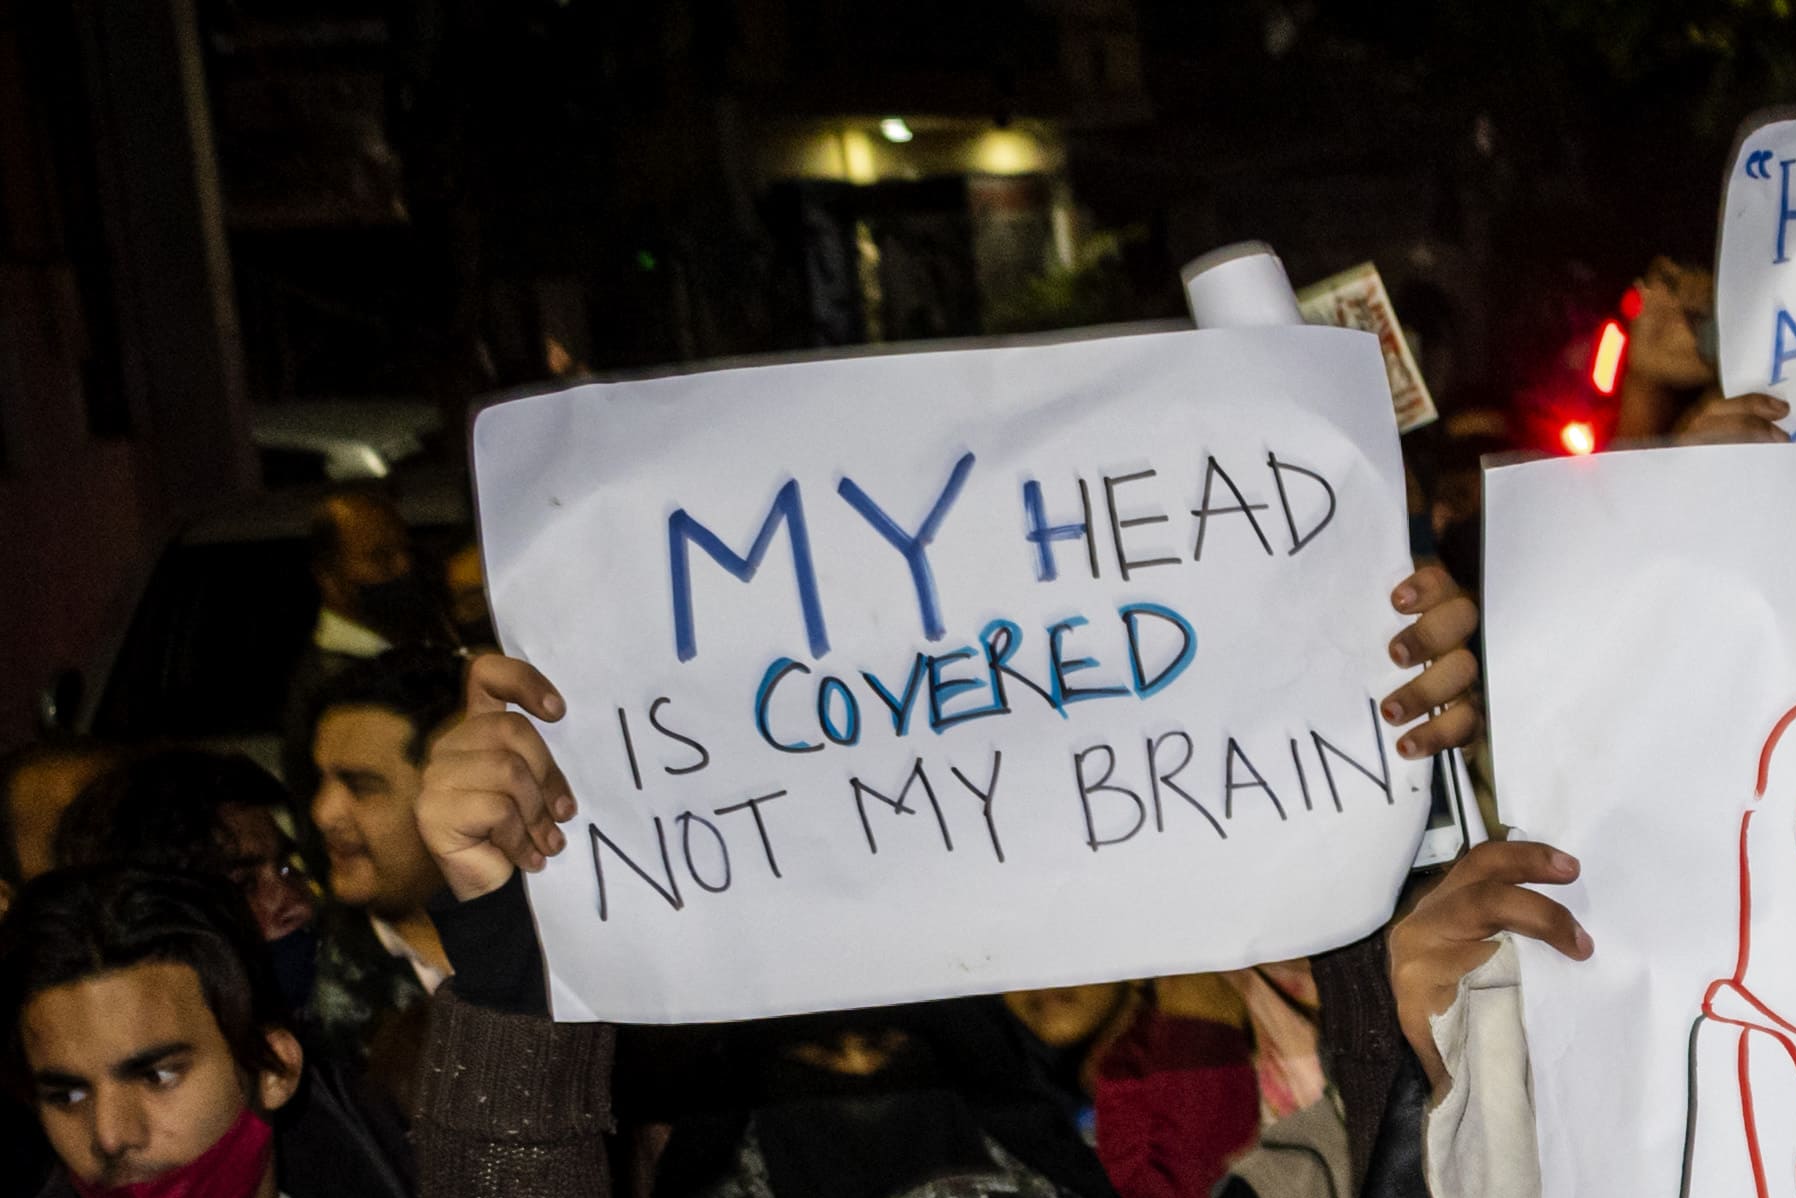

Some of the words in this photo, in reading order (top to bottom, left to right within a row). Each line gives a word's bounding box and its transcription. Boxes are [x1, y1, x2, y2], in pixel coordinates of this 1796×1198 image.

[667, 451, 976, 661] MY
[1022, 452, 1338, 582] HEAD
[617, 696, 711, 791] IS
[754, 603, 1199, 756] COVERED
[587, 790, 788, 922] NOT
[850, 749, 1006, 864] MY
